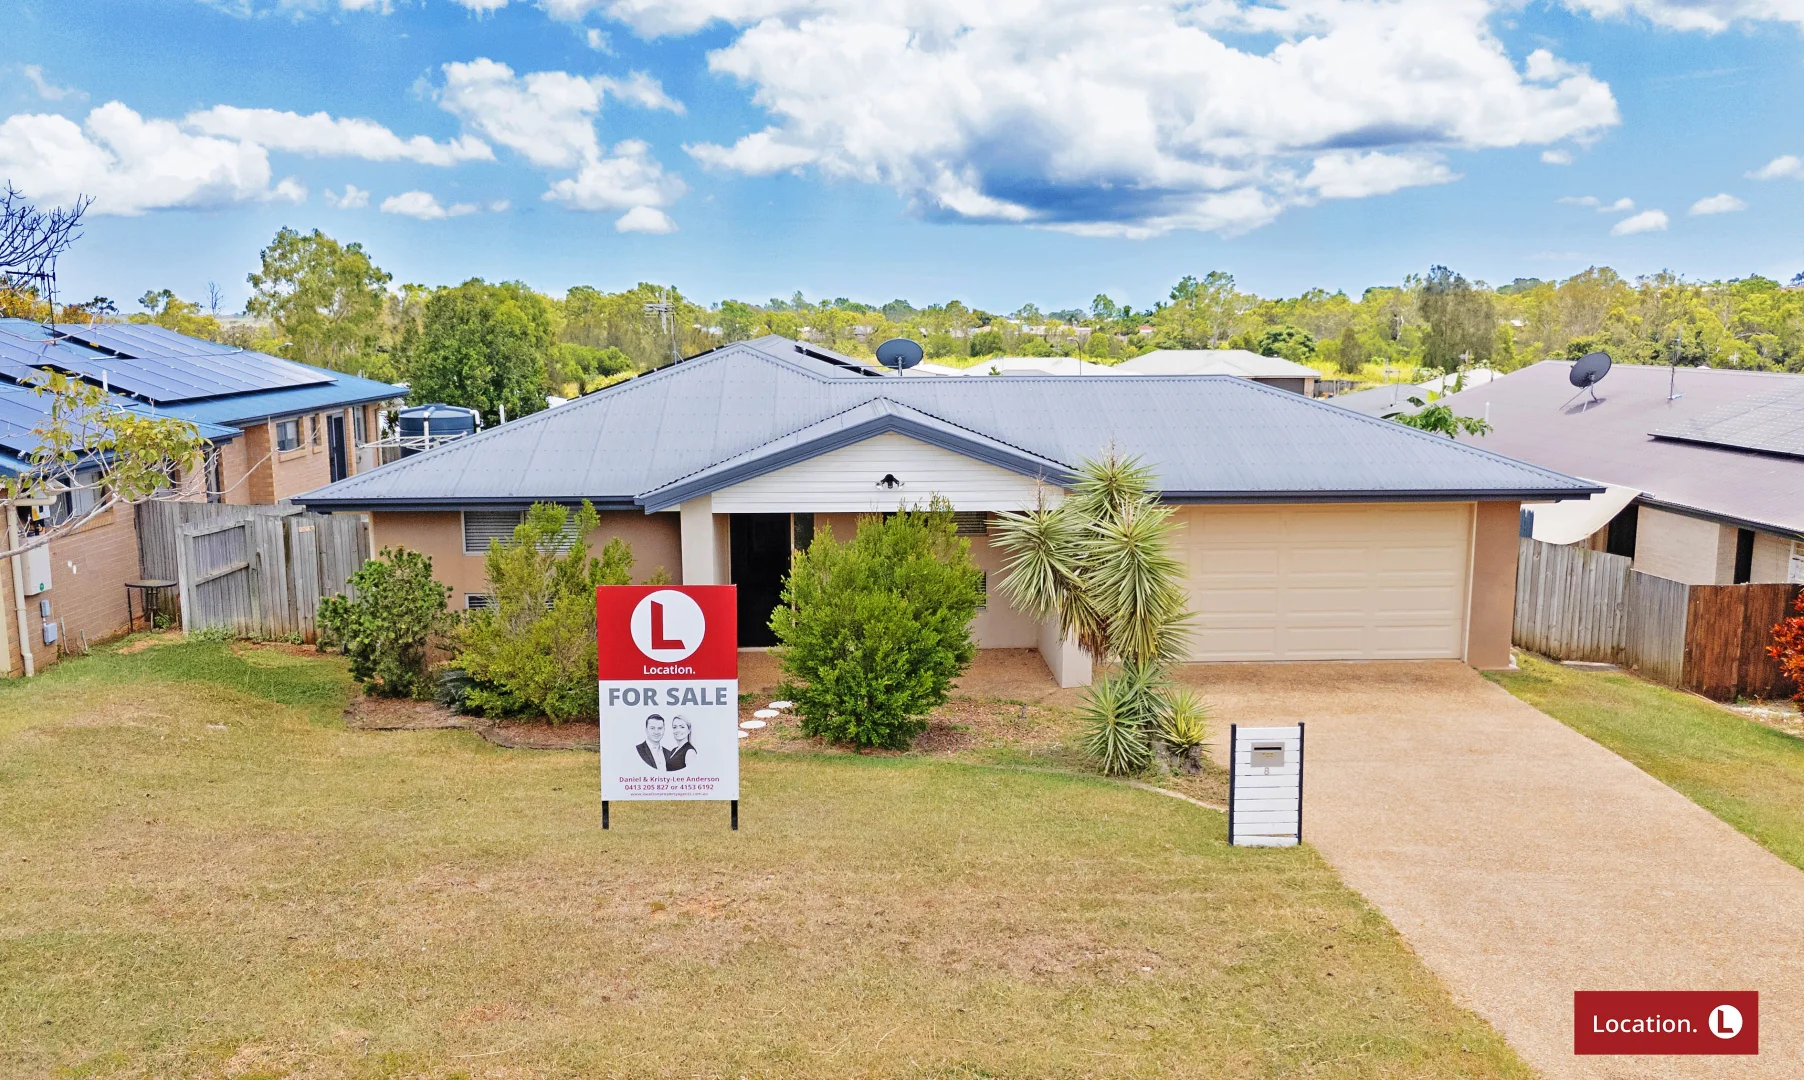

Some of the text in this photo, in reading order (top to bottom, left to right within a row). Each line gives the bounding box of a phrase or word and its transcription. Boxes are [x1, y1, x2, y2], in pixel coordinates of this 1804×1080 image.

[650, 600, 686, 650] L
[643, 665, 696, 675] Location.
[608, 687, 728, 706] FOR SALE
